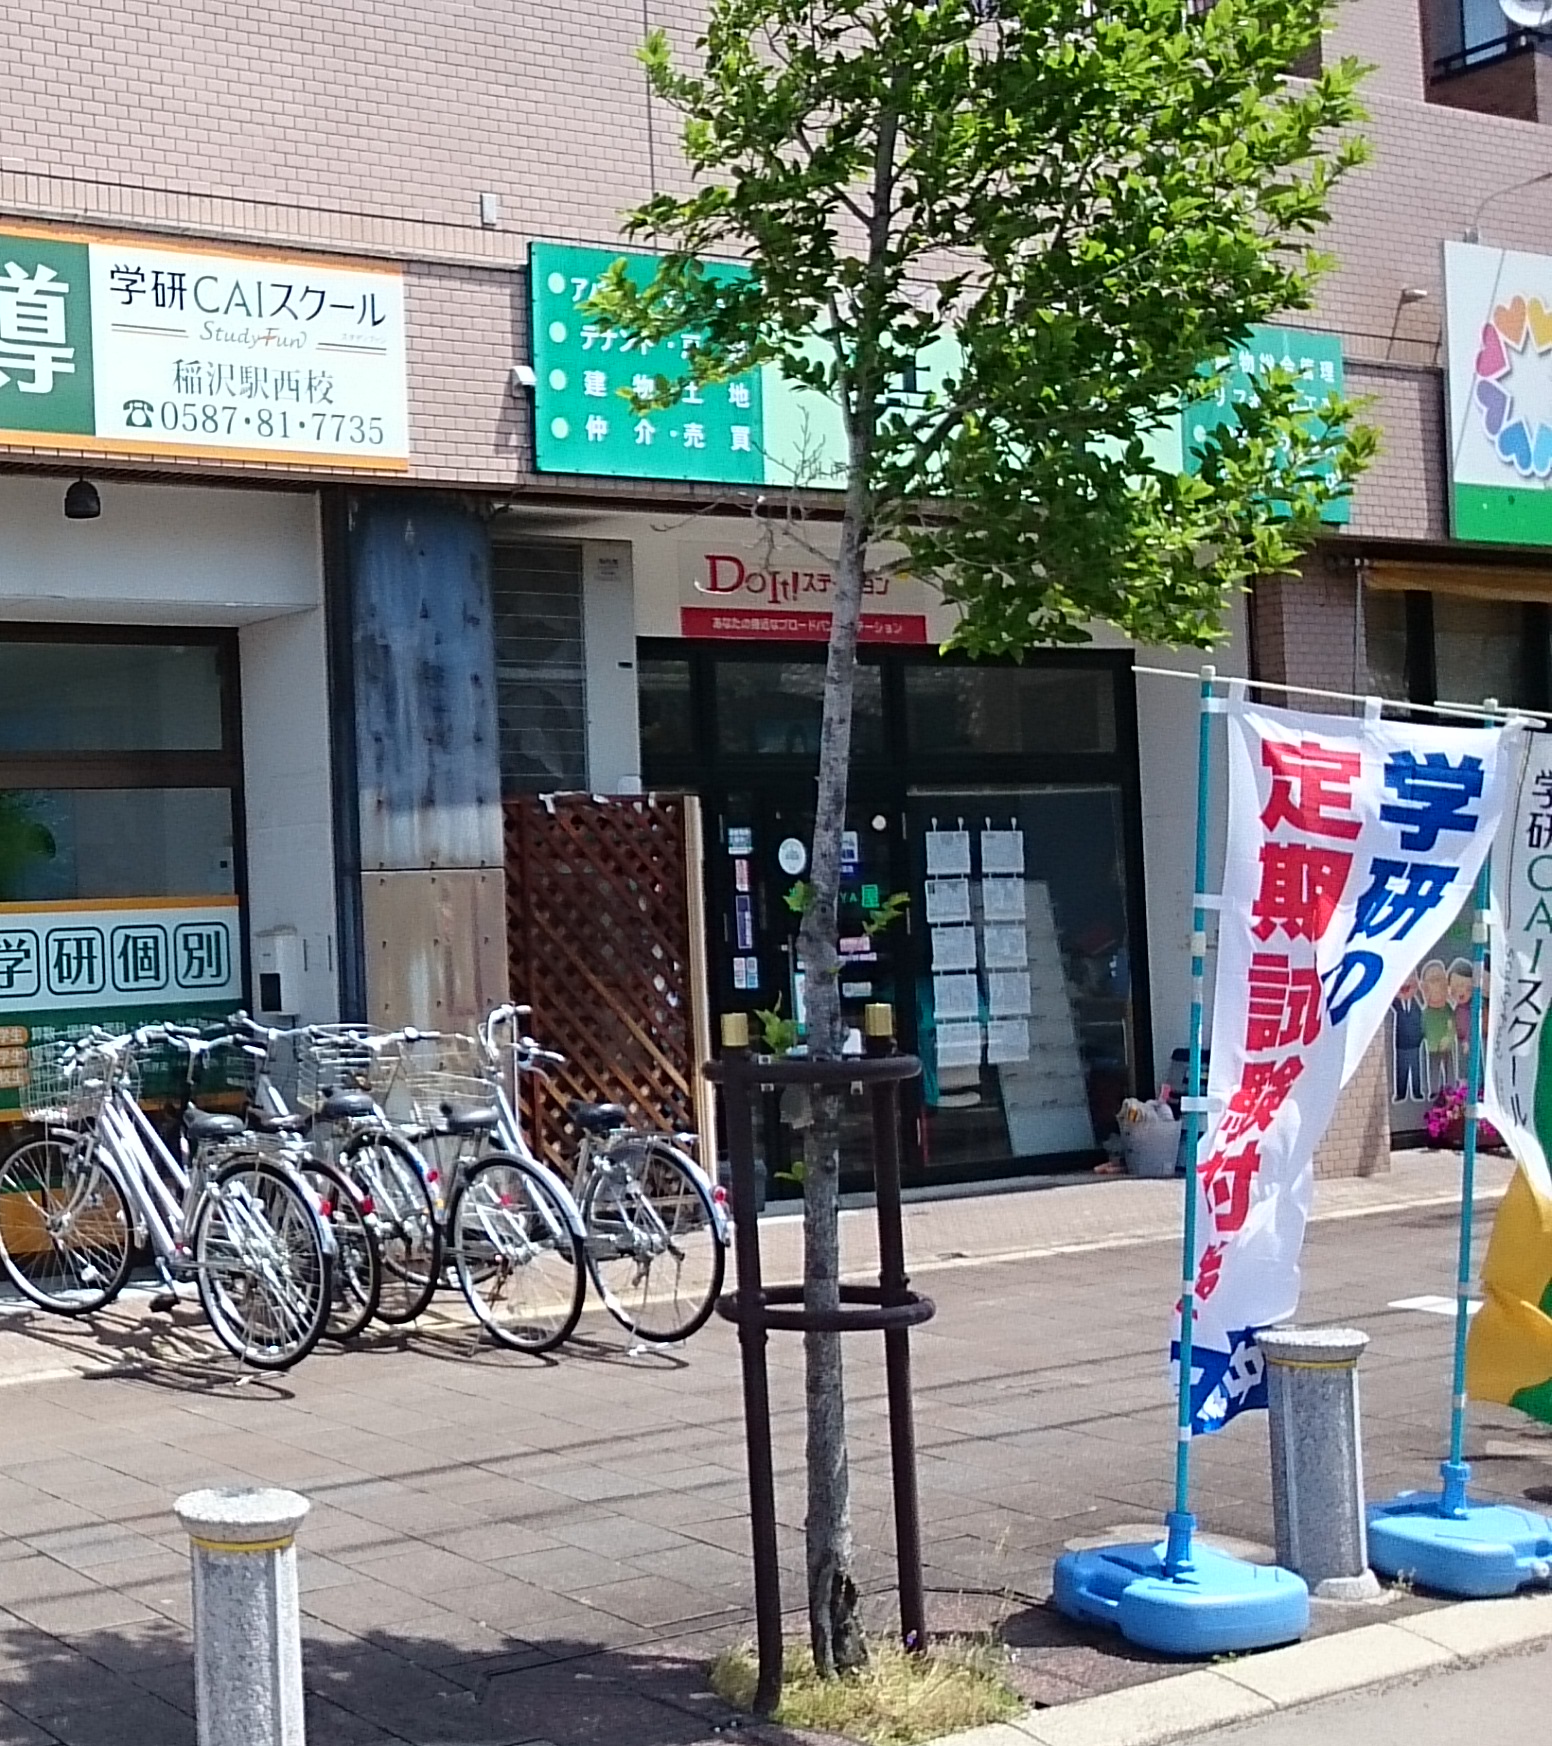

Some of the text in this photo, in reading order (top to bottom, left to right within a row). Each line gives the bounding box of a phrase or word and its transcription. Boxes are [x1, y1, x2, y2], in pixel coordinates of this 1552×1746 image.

[109, 263, 387, 327] 学研CAIスクール
[172, 358, 334, 405] 稲沢駅西校
